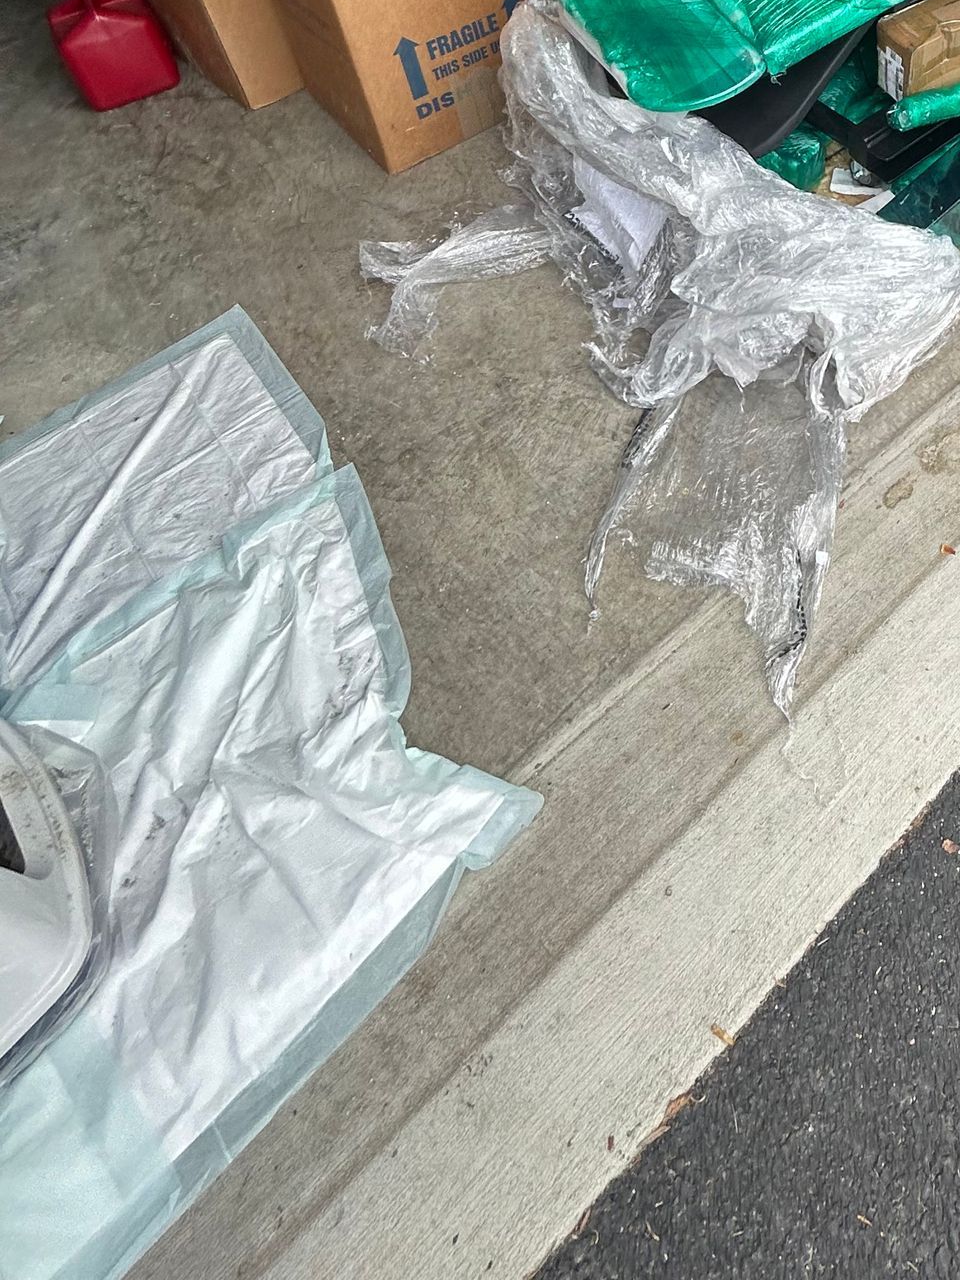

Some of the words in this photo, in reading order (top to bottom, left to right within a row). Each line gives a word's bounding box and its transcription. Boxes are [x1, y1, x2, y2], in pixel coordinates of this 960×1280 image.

[426, 13, 500, 60] FRAGILE
[432, 59, 460, 81] THIS
[463, 47, 489, 67] SIDE
